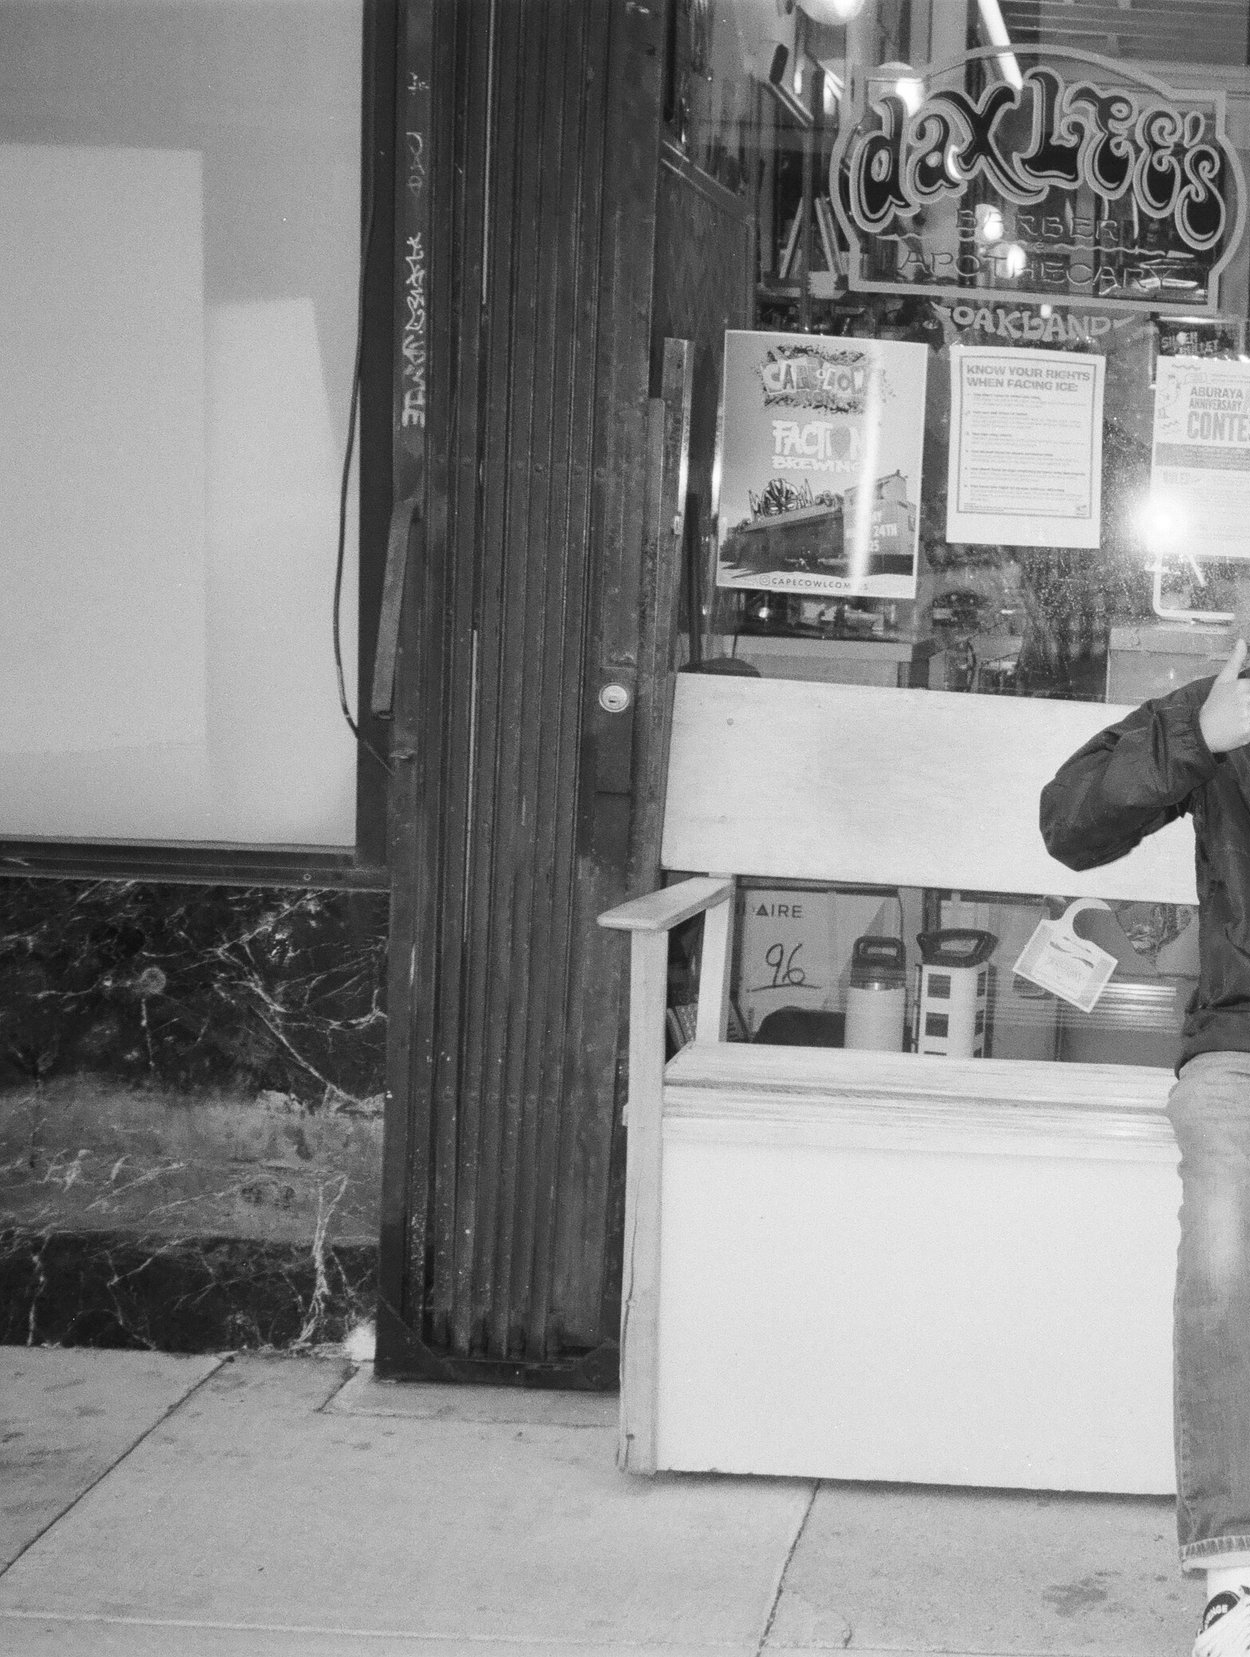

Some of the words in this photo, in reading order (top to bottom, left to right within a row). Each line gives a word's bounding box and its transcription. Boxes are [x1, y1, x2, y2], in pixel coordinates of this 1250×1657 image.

[966, 364, 1006, 376] KNOW
[1009, 366, 1043, 378] YOUR
[1046, 368, 1091, 382] RIGHTS
[966, 376, 1004, 388] WHEN
[1007, 378, 1054, 391] FACING
[1190, 386, 1244, 400] ABURAYA
[1188, 397, 1243, 412] ANNIVERSARY
[765, 942, 806, 986] 96
